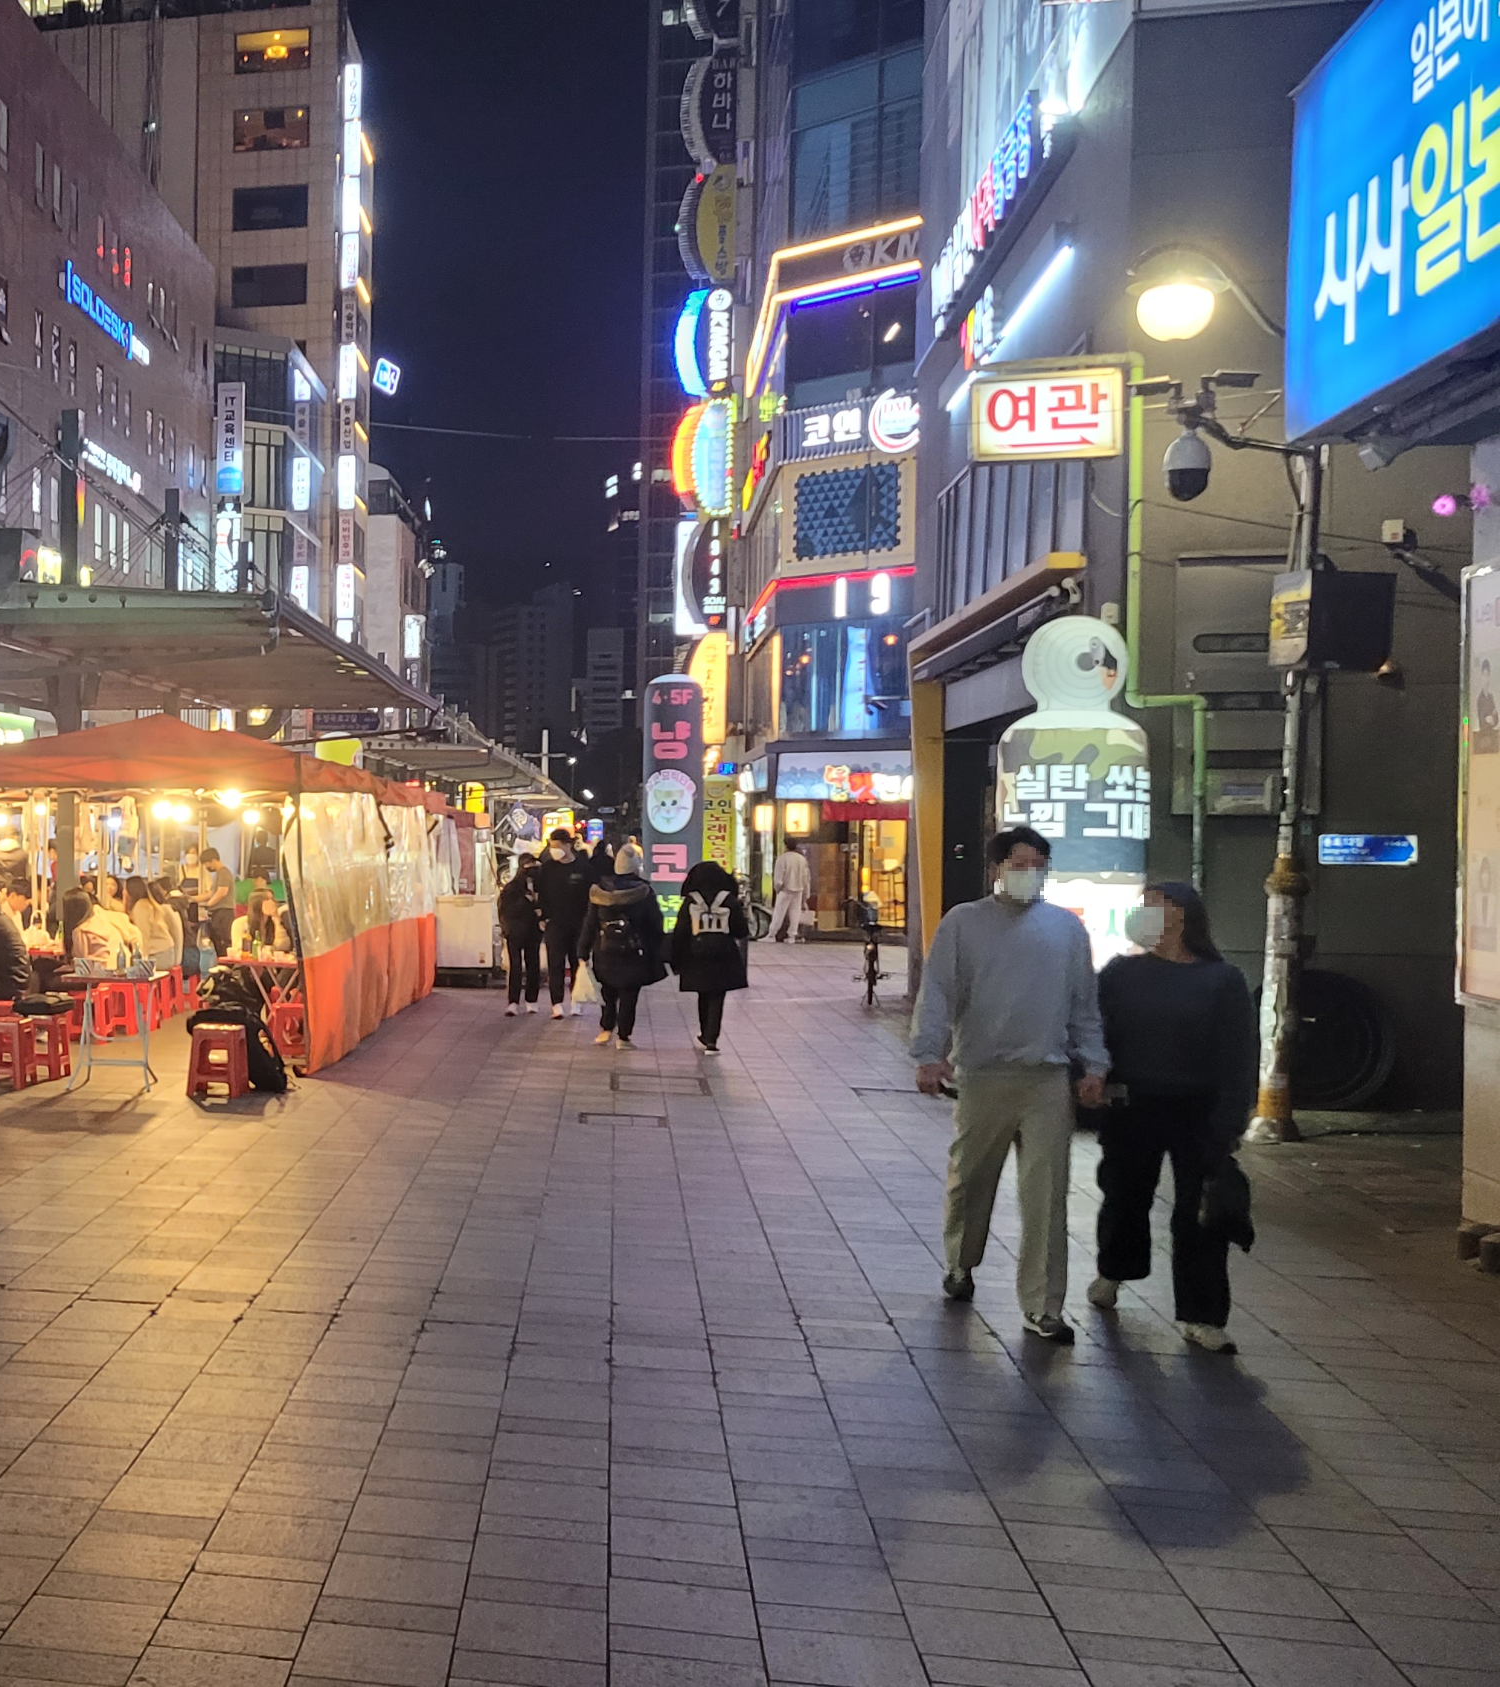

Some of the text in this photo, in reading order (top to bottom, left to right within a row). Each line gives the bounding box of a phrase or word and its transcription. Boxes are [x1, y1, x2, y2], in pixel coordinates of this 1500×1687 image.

[348, 68, 358, 116] 1987
[712, 71, 733, 130] 하바나
[709, 311, 730, 381] KMGM
[802, 407, 862, 448] 코인
[987, 382, 1108, 433] 여관
[1016, 763, 1091, 801] 실탄
[650, 843, 689, 883] 코
